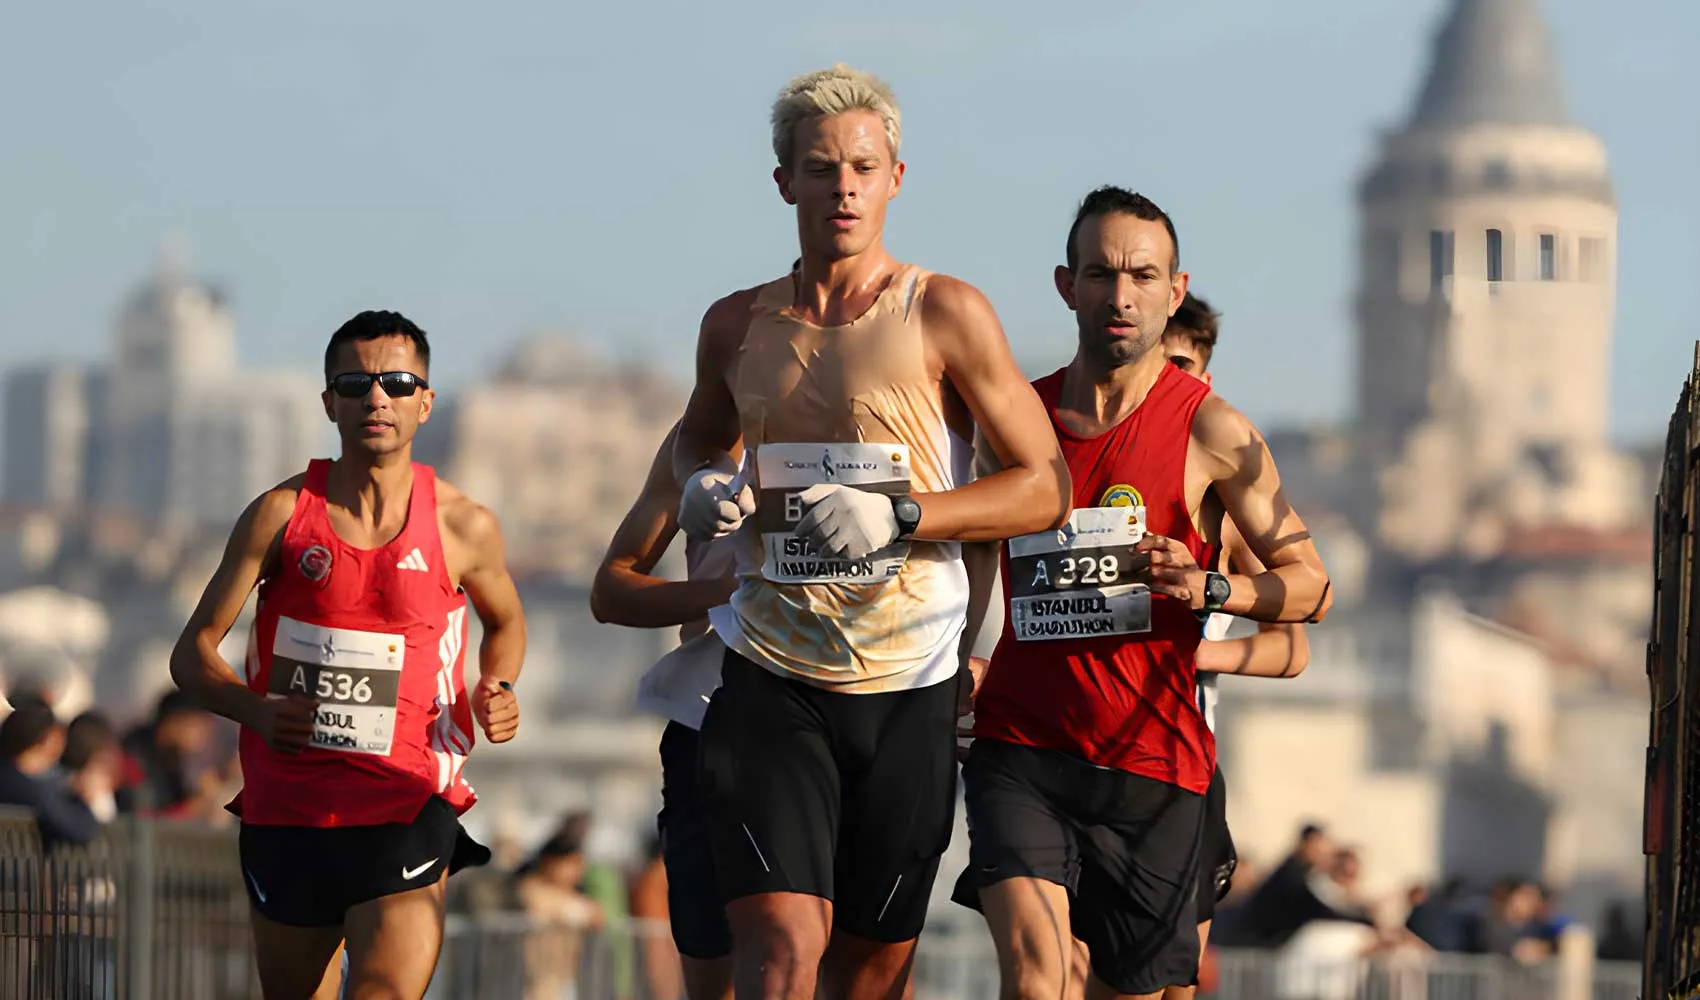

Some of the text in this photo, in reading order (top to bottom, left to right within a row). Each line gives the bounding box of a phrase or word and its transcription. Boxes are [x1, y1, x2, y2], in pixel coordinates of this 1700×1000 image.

[1031, 554, 1119, 588] A 328
[289, 664, 373, 703] A 536
